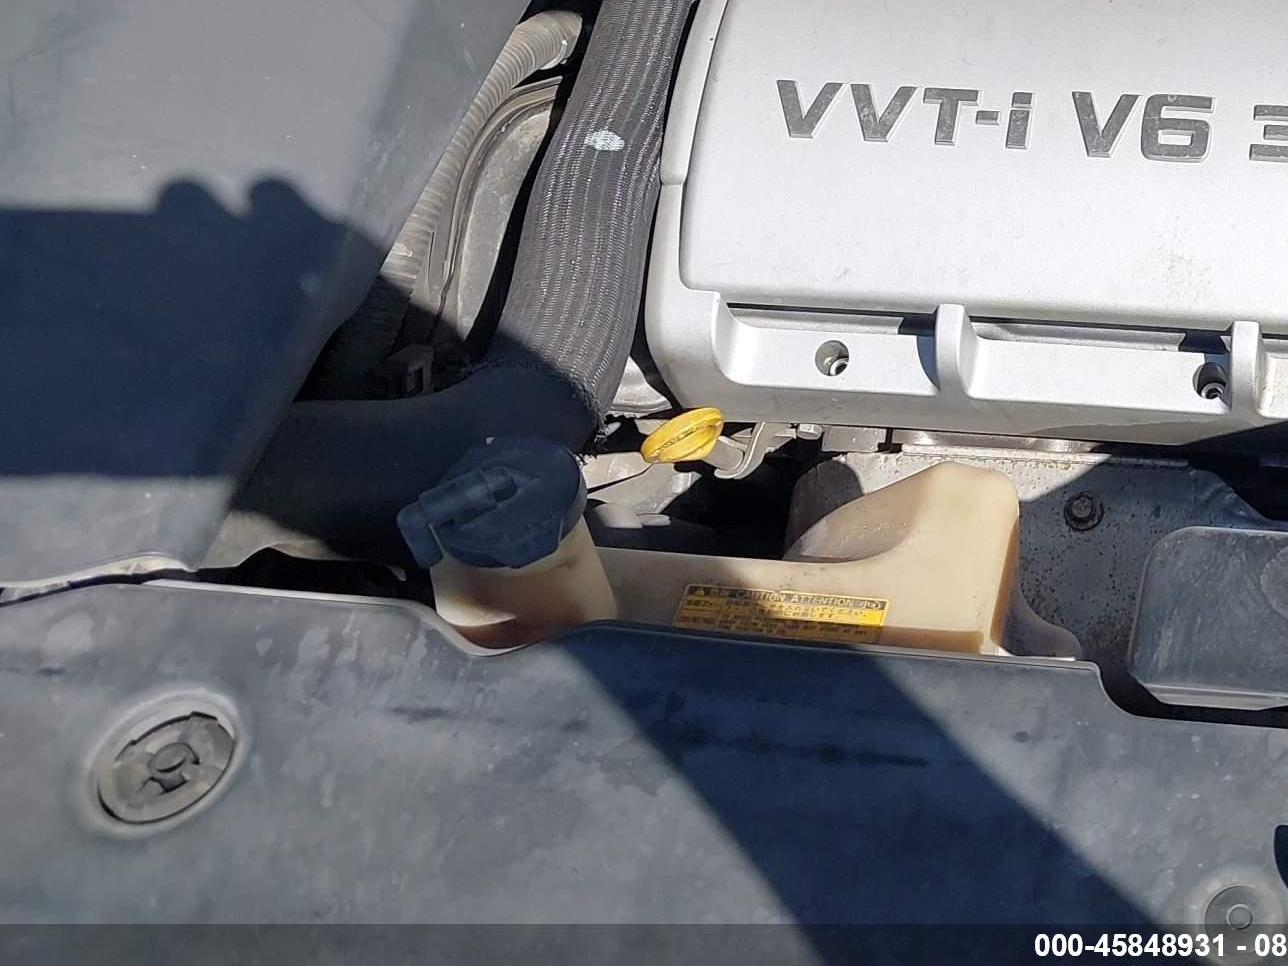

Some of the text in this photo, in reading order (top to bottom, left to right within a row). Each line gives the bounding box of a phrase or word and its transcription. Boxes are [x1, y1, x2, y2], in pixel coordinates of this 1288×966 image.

[776, 79, 1036, 150] VVT-i
[1070, 90, 1217, 163] V6
[791, 594, 854, 607] ATTENTION
